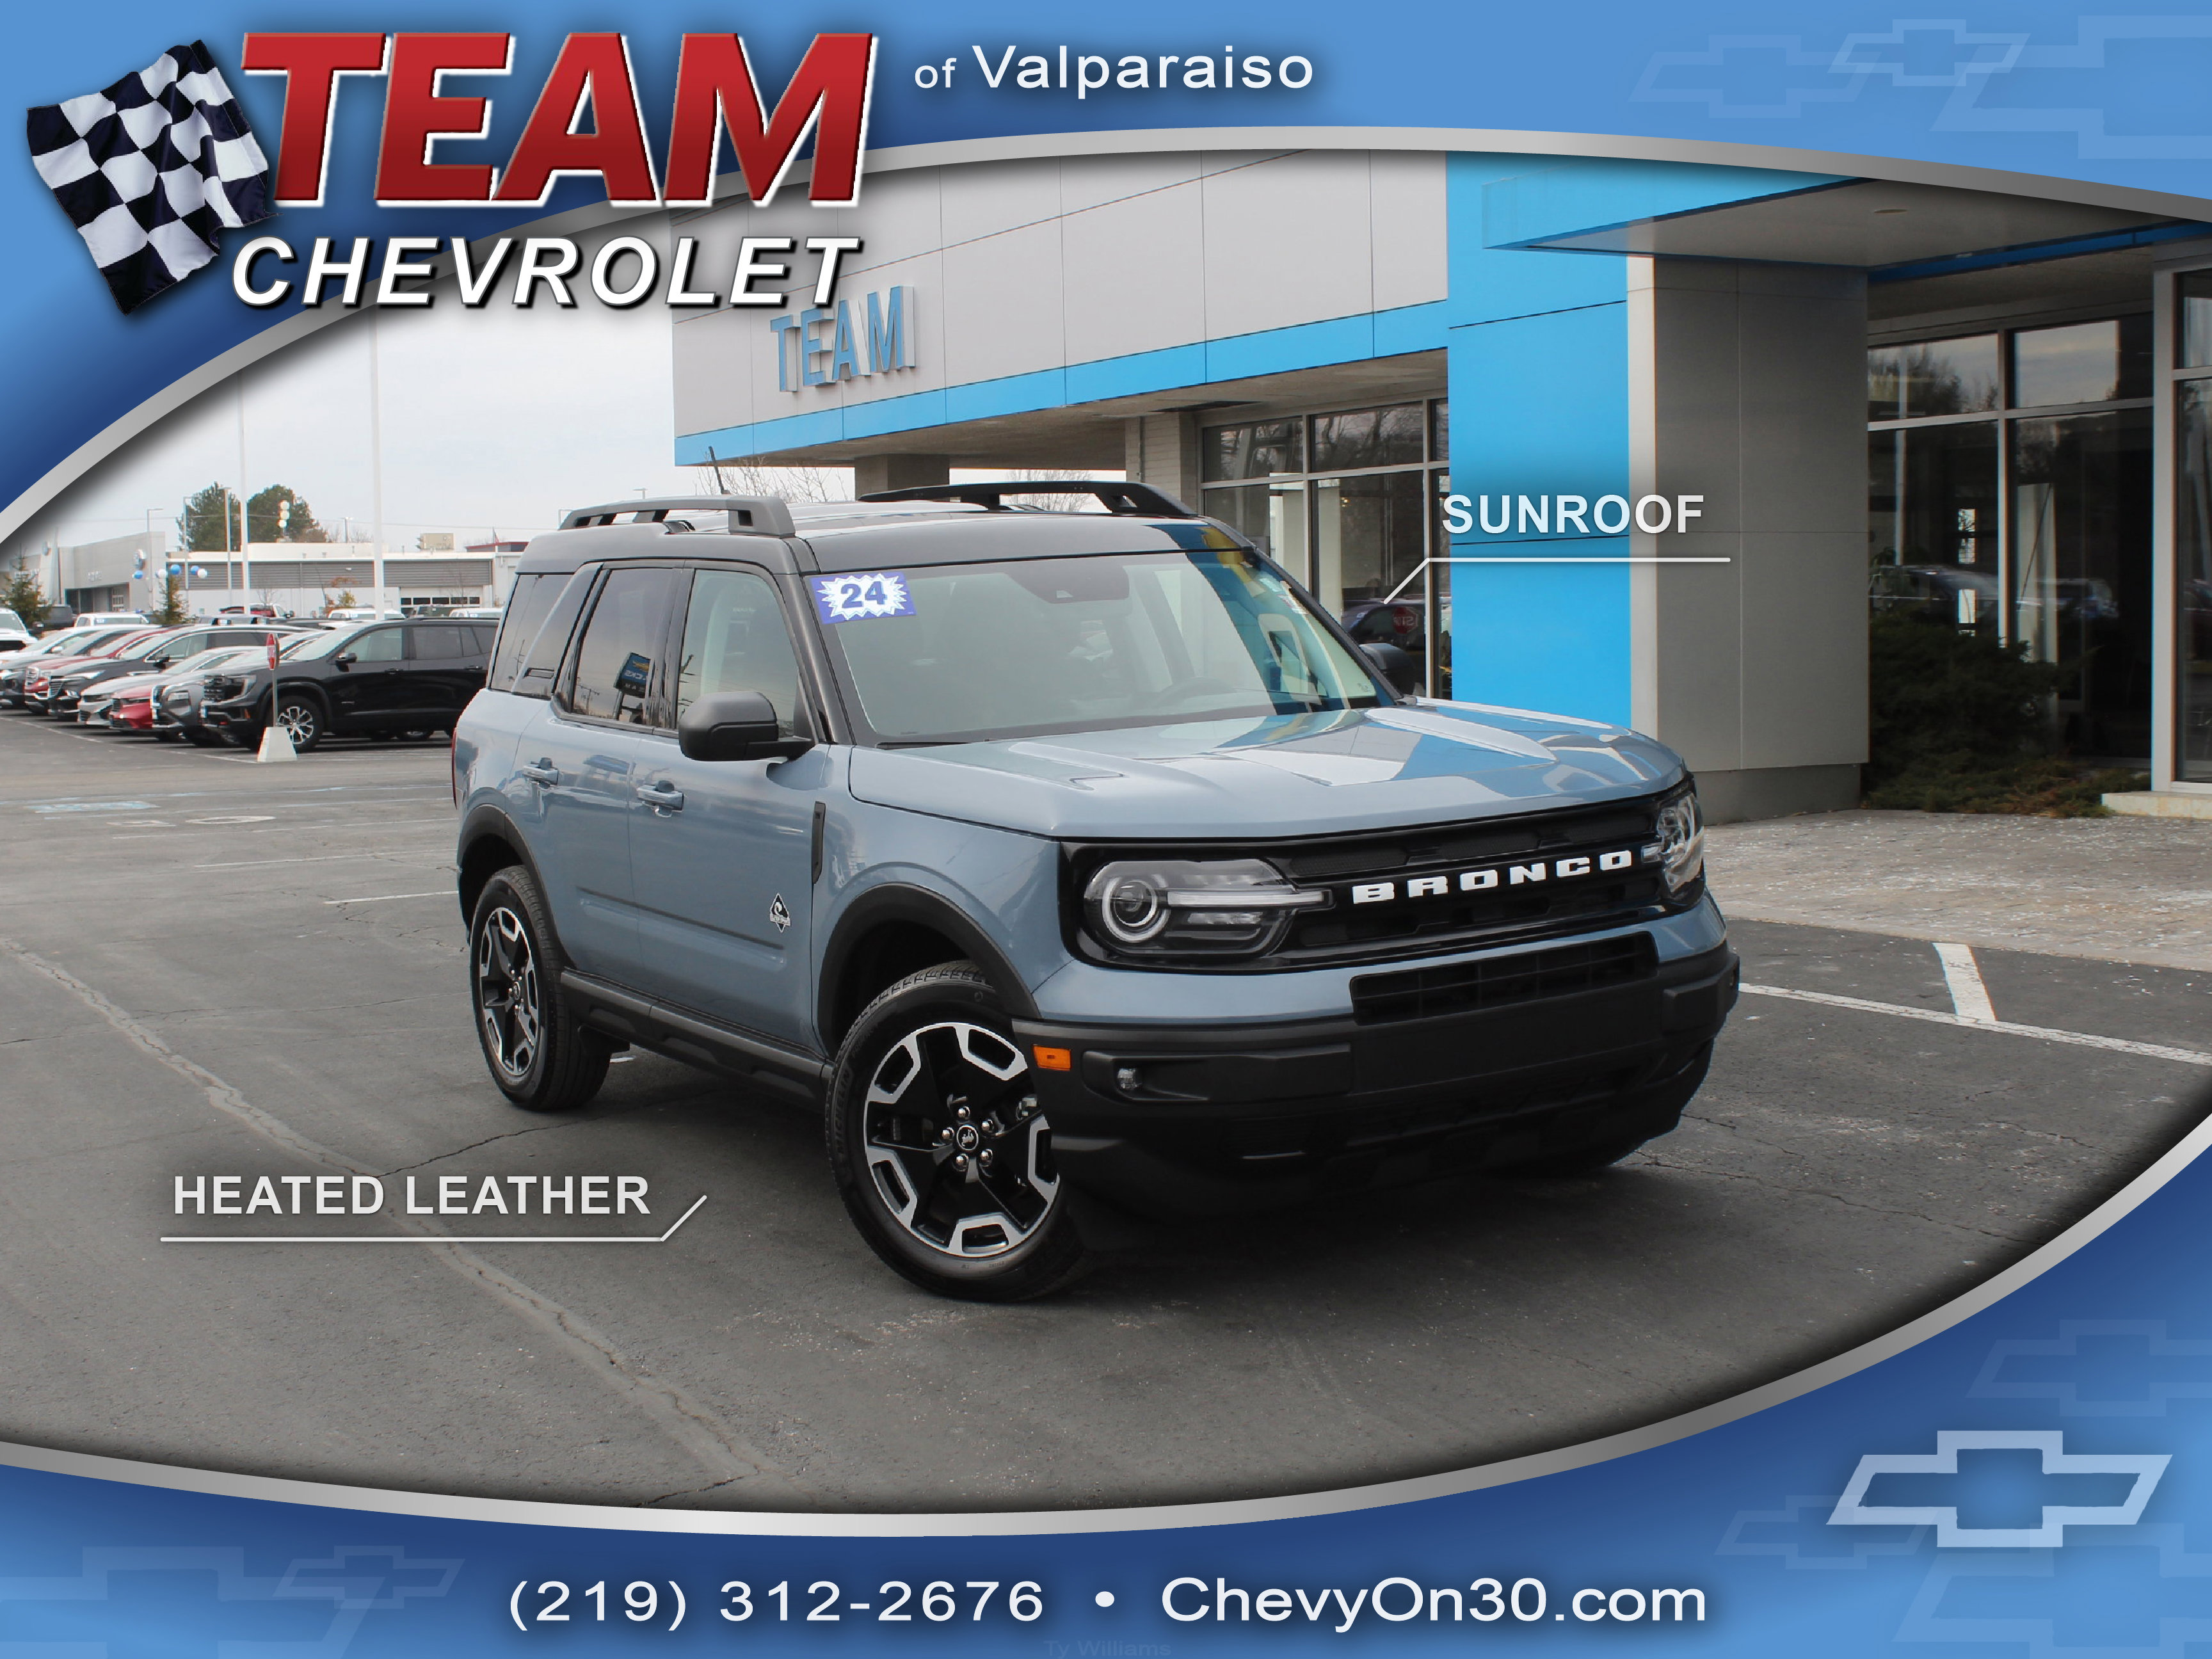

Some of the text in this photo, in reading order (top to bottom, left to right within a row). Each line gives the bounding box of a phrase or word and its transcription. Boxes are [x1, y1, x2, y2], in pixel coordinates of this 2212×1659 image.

[770, 286, 914, 392] TEAM
[840, 581, 888, 609] 24
[1352, 850, 1631, 904] BRONCO
